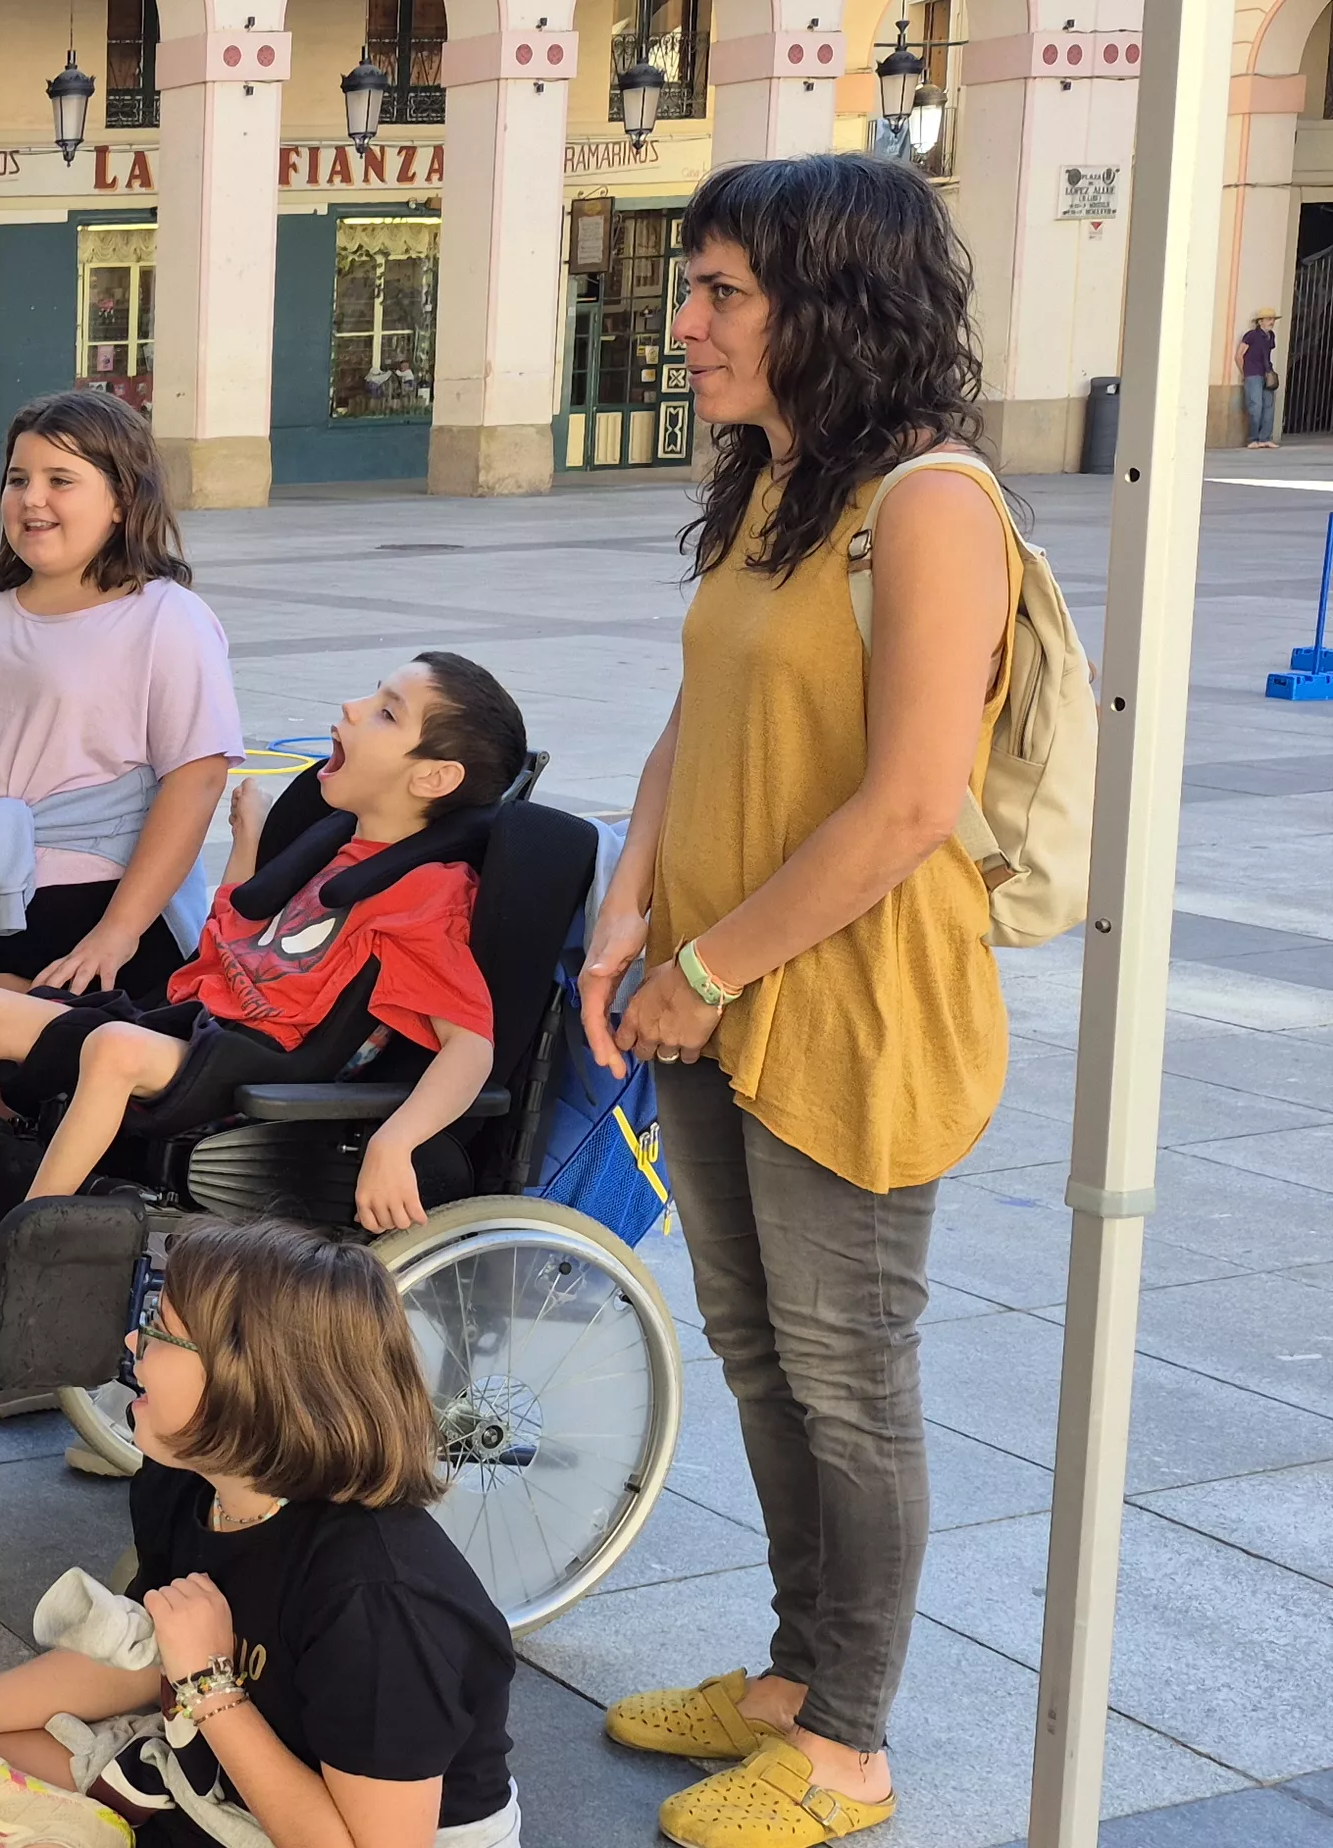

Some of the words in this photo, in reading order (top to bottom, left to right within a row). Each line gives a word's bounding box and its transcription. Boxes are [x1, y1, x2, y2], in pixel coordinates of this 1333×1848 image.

[93, 145, 154, 191] LA
[278, 145, 445, 187] FIANZA
[563, 140, 660, 173] RAMARINOS
